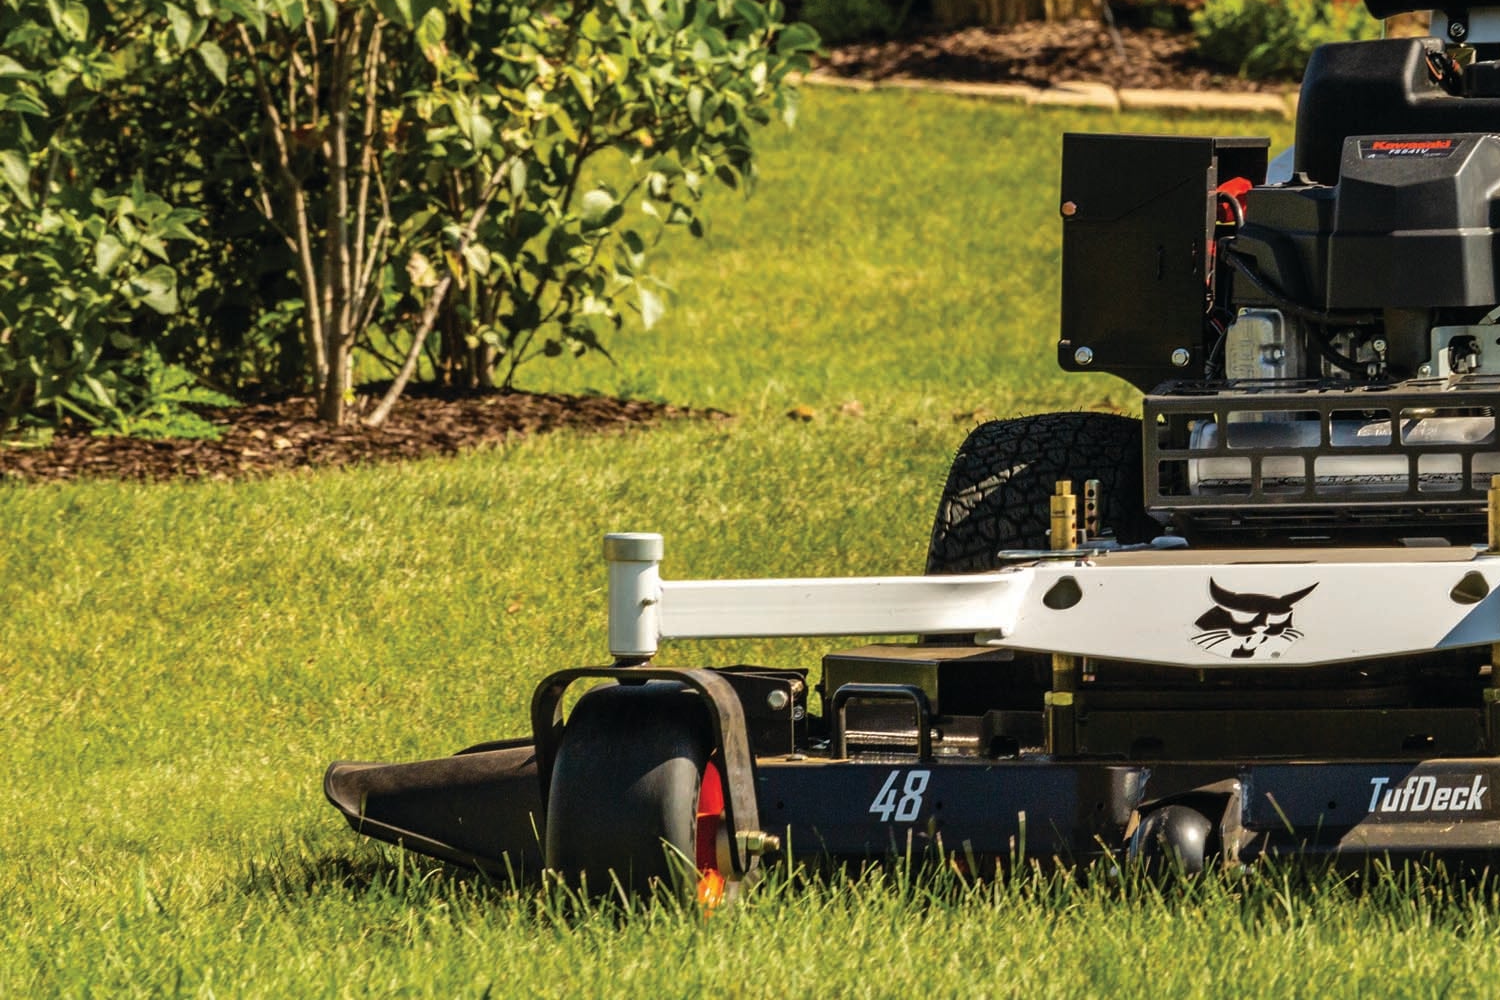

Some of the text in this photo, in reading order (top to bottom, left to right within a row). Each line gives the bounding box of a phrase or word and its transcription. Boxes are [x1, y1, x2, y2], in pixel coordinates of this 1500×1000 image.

[1373, 139, 1452, 150] Kawasaki
[869, 770, 931, 822] 48
[1367, 775, 1488, 812] TufDeck
